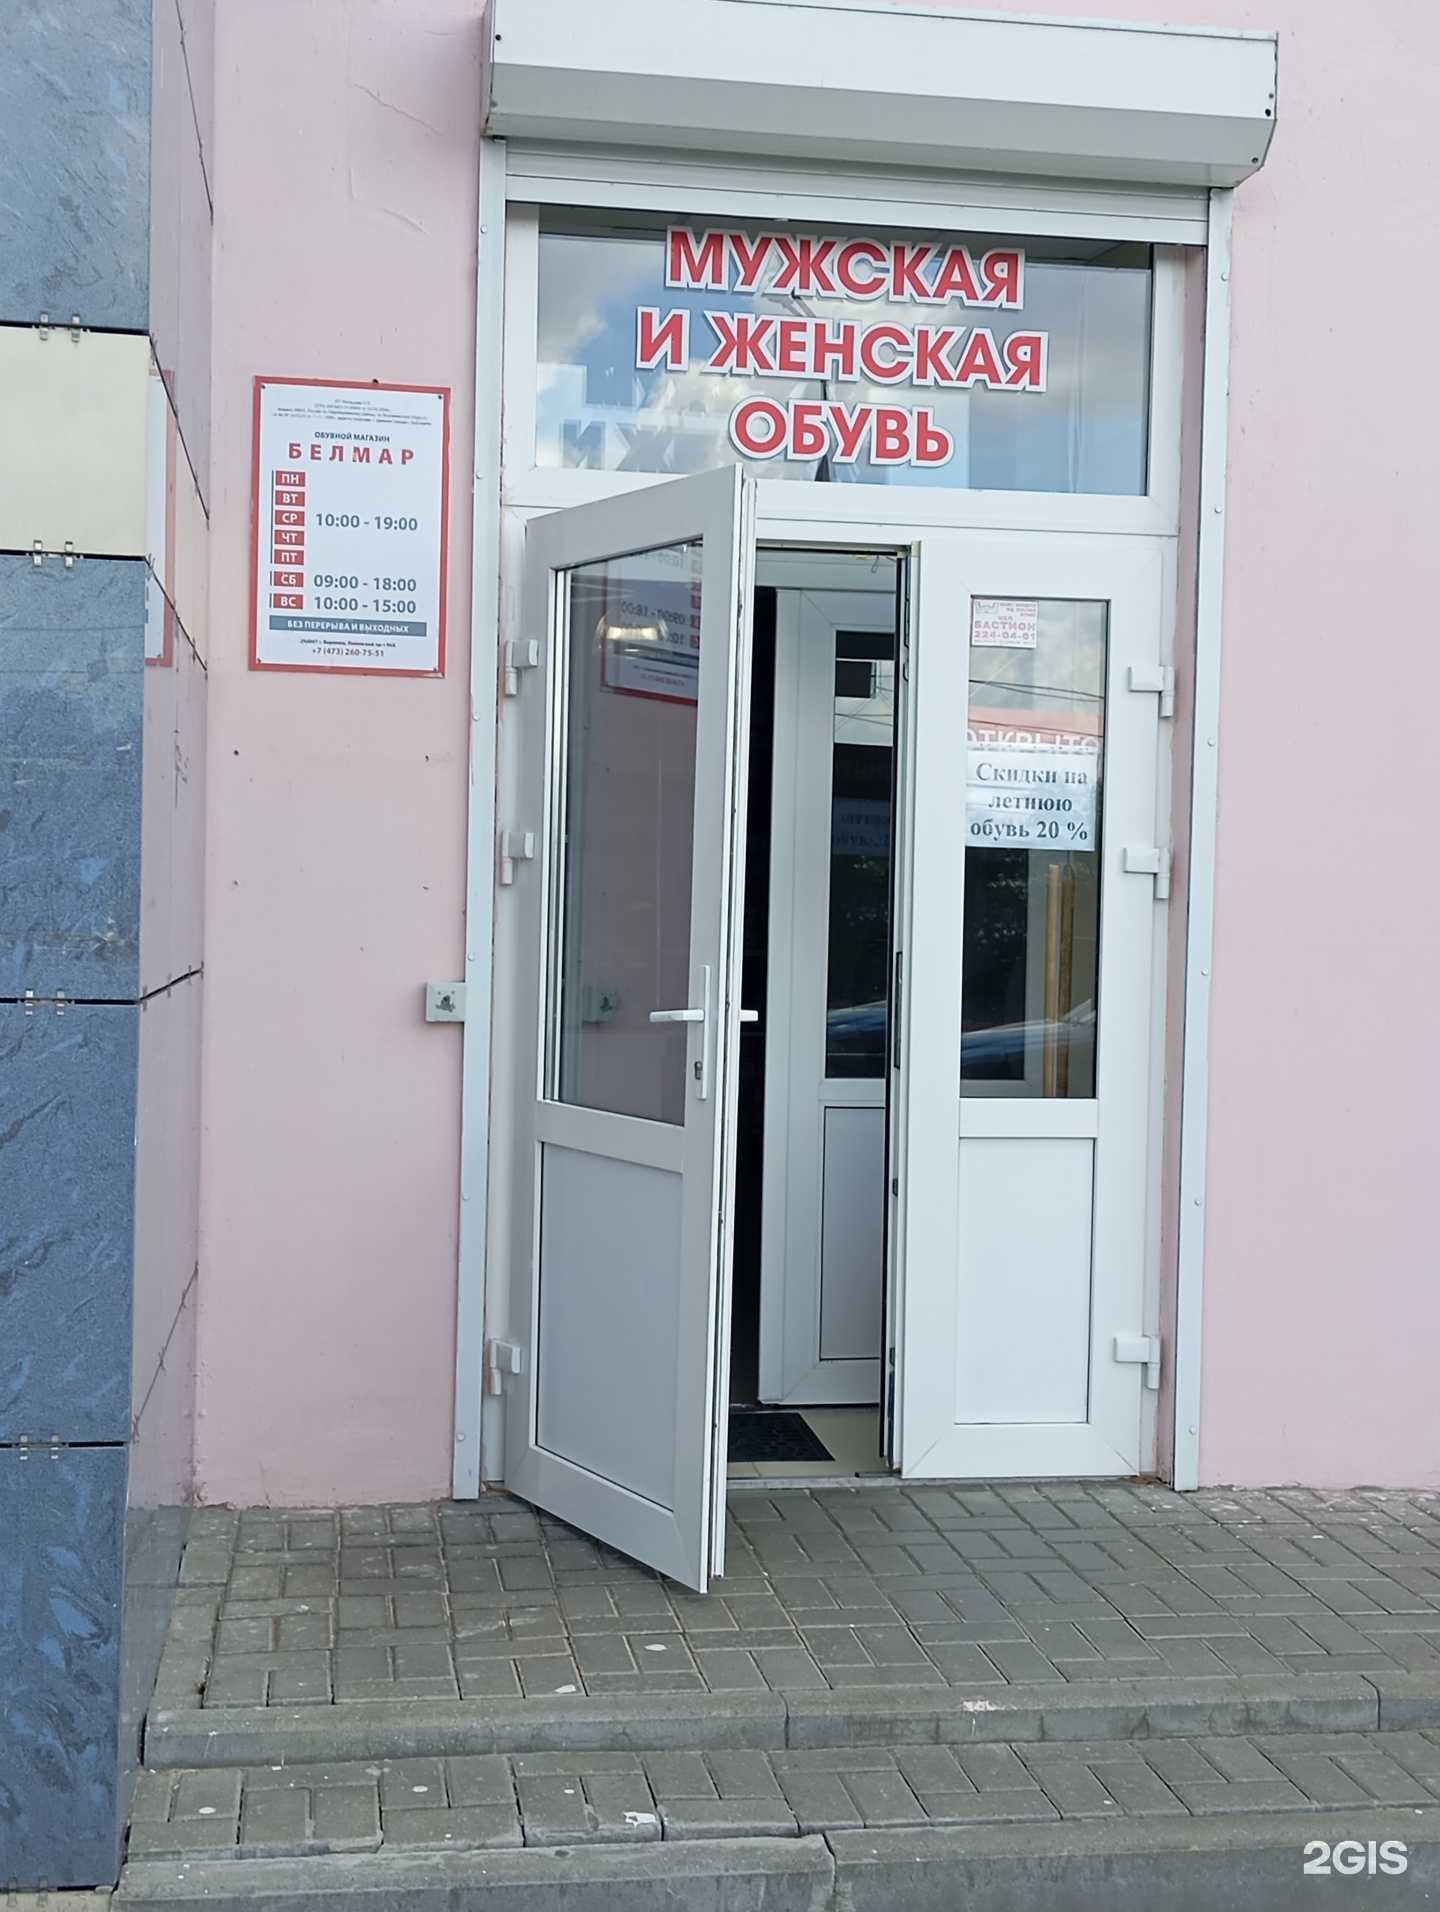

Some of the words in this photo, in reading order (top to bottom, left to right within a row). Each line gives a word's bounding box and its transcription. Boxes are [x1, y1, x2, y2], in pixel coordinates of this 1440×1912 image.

[667, 227, 1024, 309] МУЖСКАЯ
[638, 308, 690, 370] И
[704, 311, 1048, 392] ЖЕНСКАЯ
[314, 431, 352, 441] ОБУВНОЙ
[354, 433, 390, 443] МАГАЗИН
[731, 396, 953, 467] ОБУВЬ
[289, 443, 414, 465] БЕЛМАР
[281, 473, 299, 485] ПН
[282, 493, 298, 504] ВТ
[282, 512, 298, 524] СР
[316, 513, 360, 528] 10:00
[374, 516, 418, 531] 19:00
[282, 532, 298, 543] ЧТ
[281, 552, 297, 563] ПТ
[280, 573, 296, 585] СБ
[314, 574, 359, 589] 09:00
[373, 577, 417, 592] 18:00
[280, 596, 297, 607] ВС
[314, 596, 358, 611] 10:00
[373, 599, 416, 614] 15:00
[287, 619, 303, 629] БЕЗ
[304, 621, 350, 631] ПЕРЕРЫВА
[351, 623, 357, 631] И
[359, 623, 409, 634] ВЫХОДНЫХ
[974, 620, 1035, 631] БАСТИОН
[323, 647, 343, 656] (473)
[976, 762, 1057, 784] Скидки
[1064, 771, 1088, 784] на
[988, 795, 1072, 812] летнюю
[970, 819, 1029, 841] обувь
[1036, 821, 1059, 839] 20
[1067, 822, 1088, 840] %
